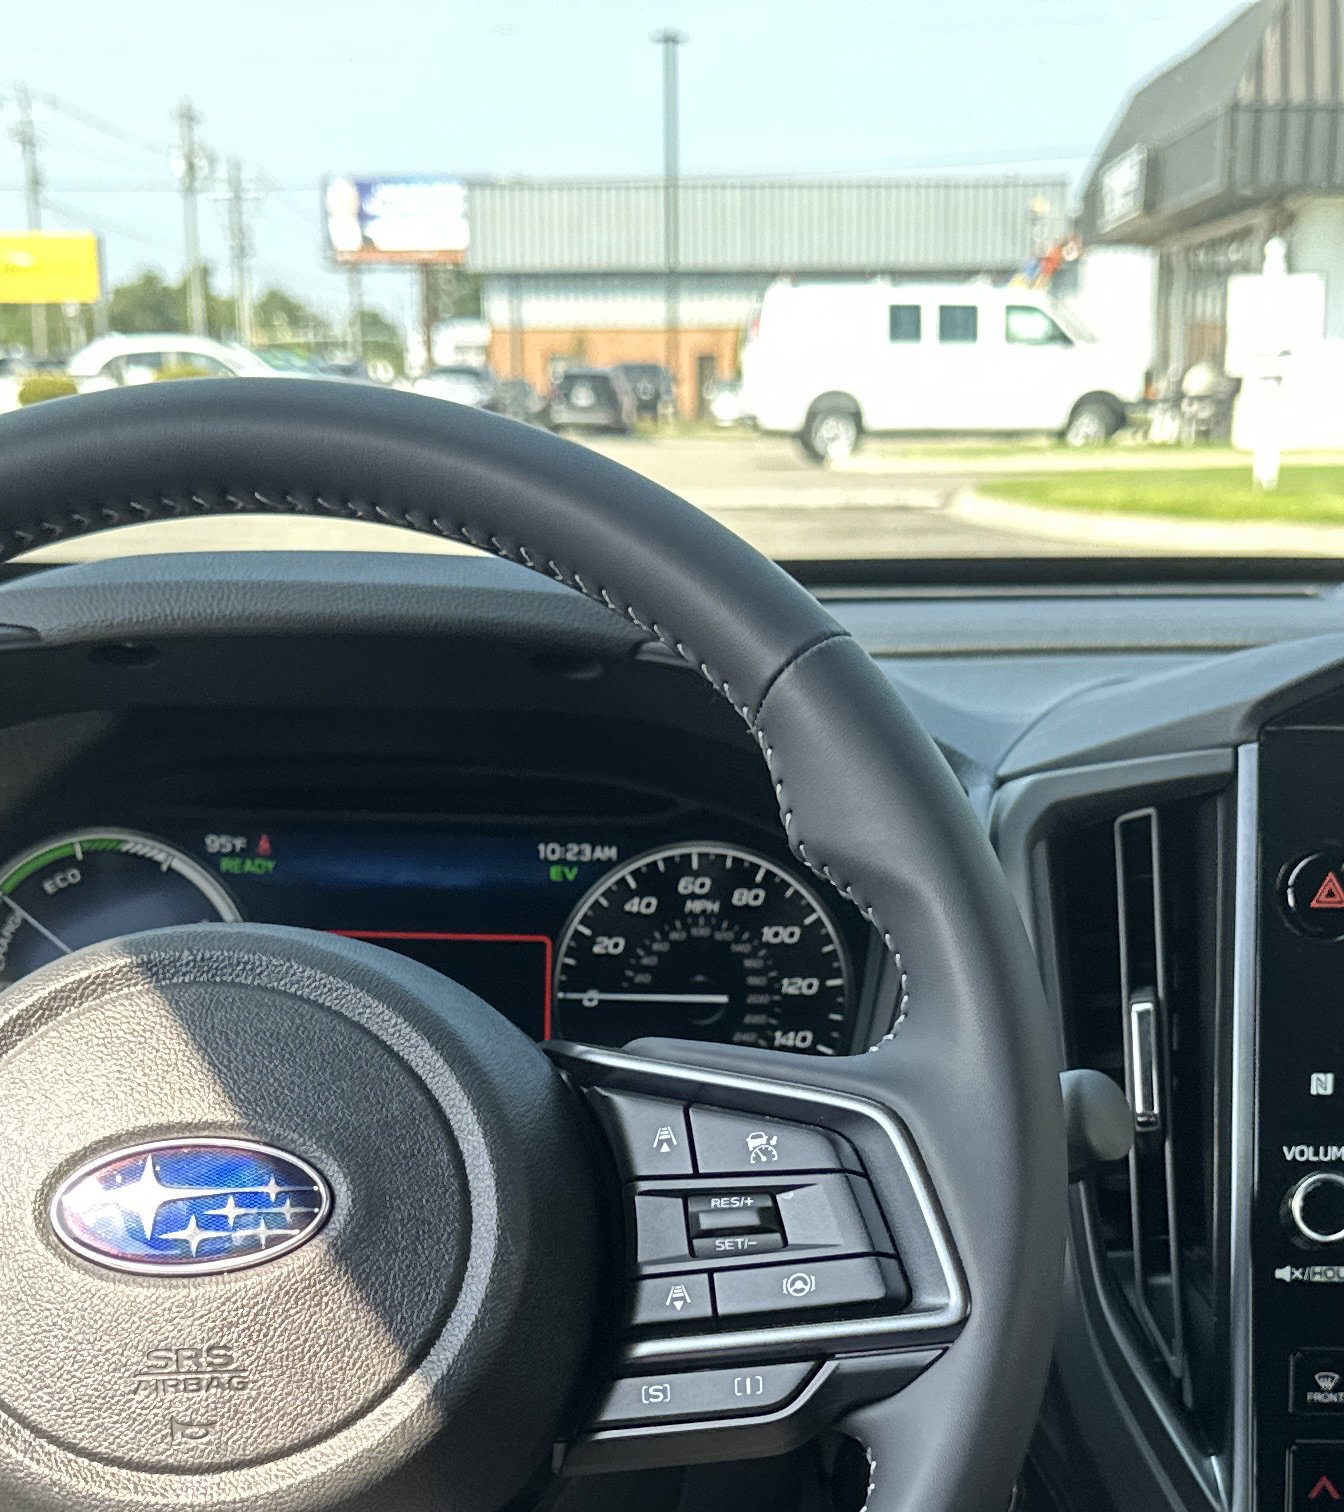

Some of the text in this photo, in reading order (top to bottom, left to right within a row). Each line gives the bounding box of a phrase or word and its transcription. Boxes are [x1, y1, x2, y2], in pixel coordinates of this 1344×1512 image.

[219, 857, 277, 875] READY
[549, 864, 578, 881] EV
[42, 868, 81, 895] ECO
[677, 876, 711, 895] 60
[624, 896, 658, 915] 40
[684, 899, 720, 914] MPH
[731, 888, 766, 906] 80
[761, 925, 801, 944] 100
[592, 936, 625, 955] 20
[781, 977, 819, 996] 120
[774, 1030, 813, 1048] 140
[146, 1346, 234, 1372] SRS
[134, 1376, 249, 1395] AIRBAG
[1306, 1391, 1344, 1402] FRONT
